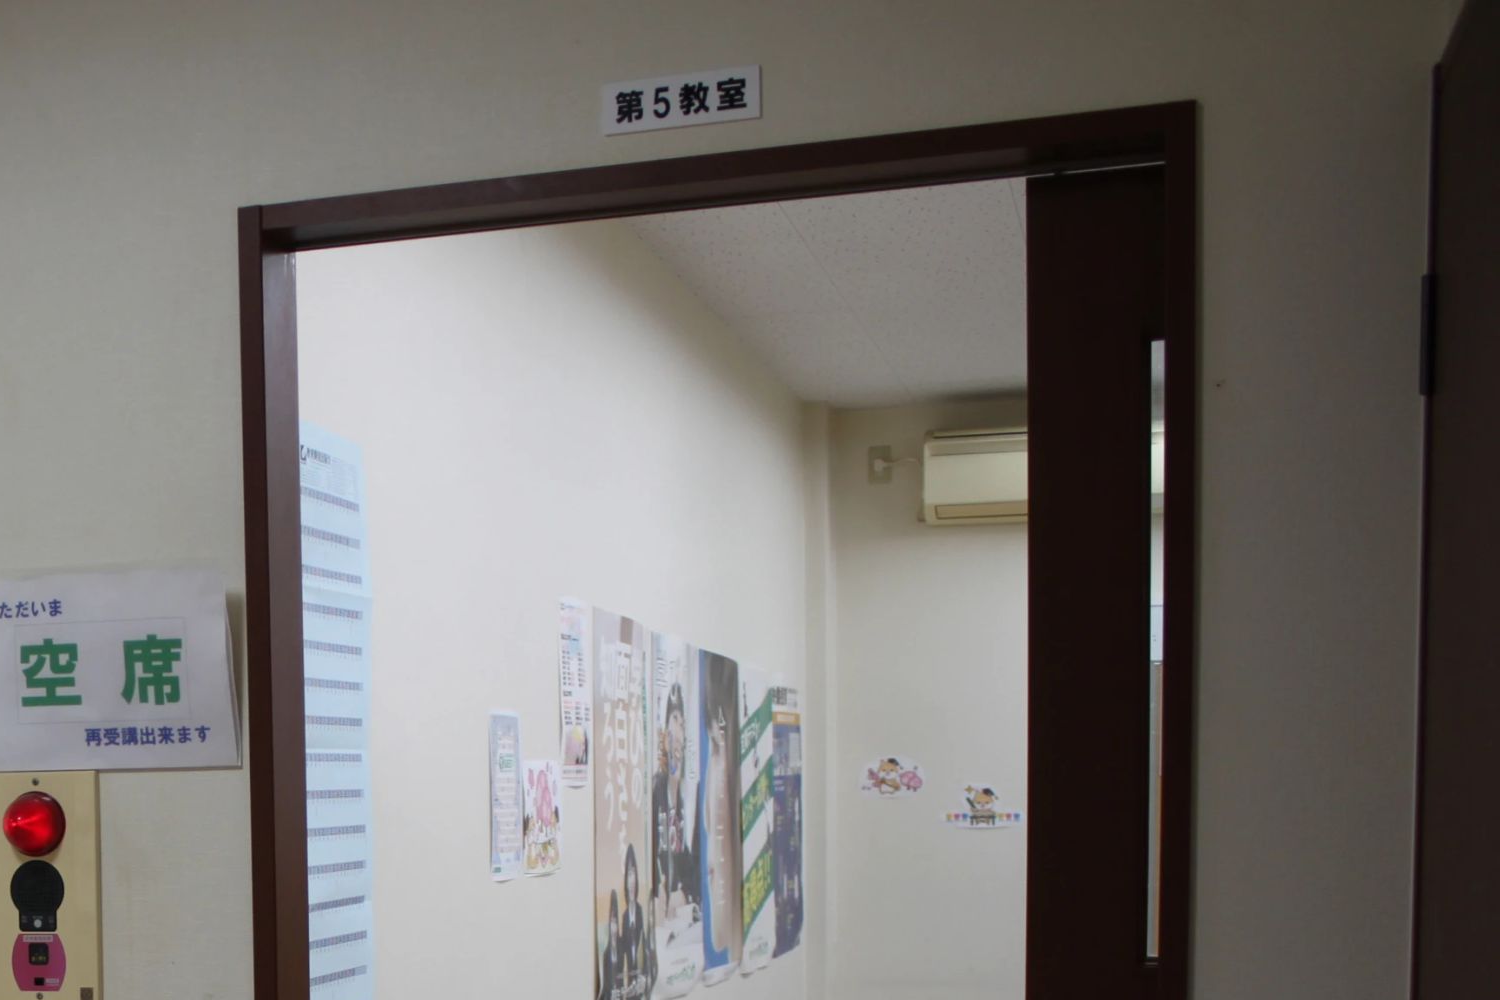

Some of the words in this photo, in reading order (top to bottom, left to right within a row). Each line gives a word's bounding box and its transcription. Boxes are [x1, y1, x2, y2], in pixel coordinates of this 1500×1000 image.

[615, 77, 747, 123] 第5教室
[84, 725, 211, 747] 再受講出来ます
